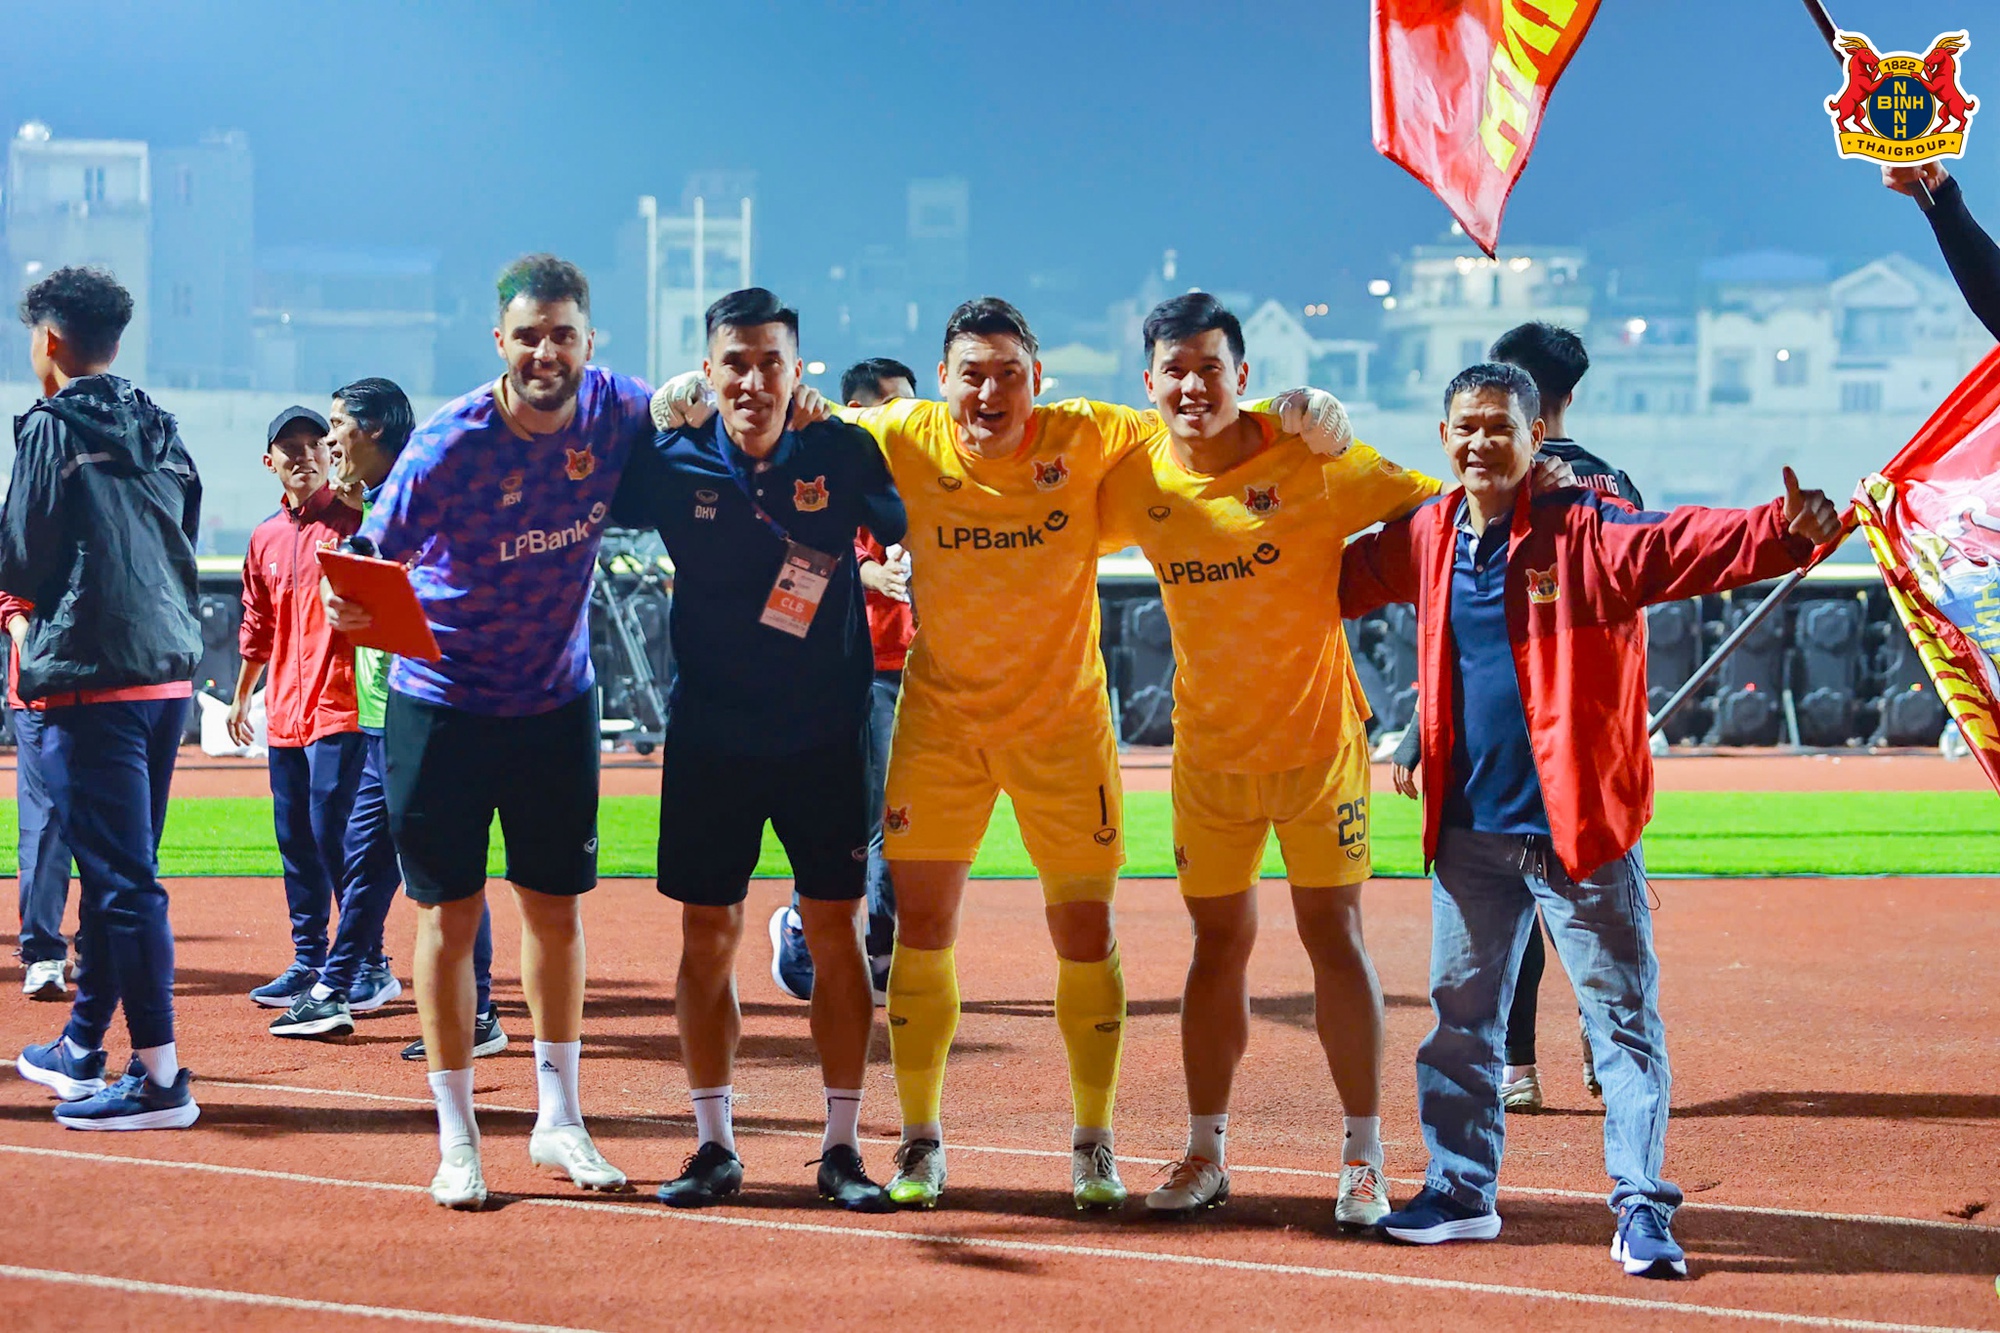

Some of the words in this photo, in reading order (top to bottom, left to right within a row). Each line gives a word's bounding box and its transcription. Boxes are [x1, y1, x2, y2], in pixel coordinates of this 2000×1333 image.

[500, 519, 590, 562] LPBank
[937, 525, 1044, 549] LPBank
[1158, 555, 1255, 585] LPBank
[781, 597, 805, 613] CLB
[1337, 796, 1367, 847] 25
